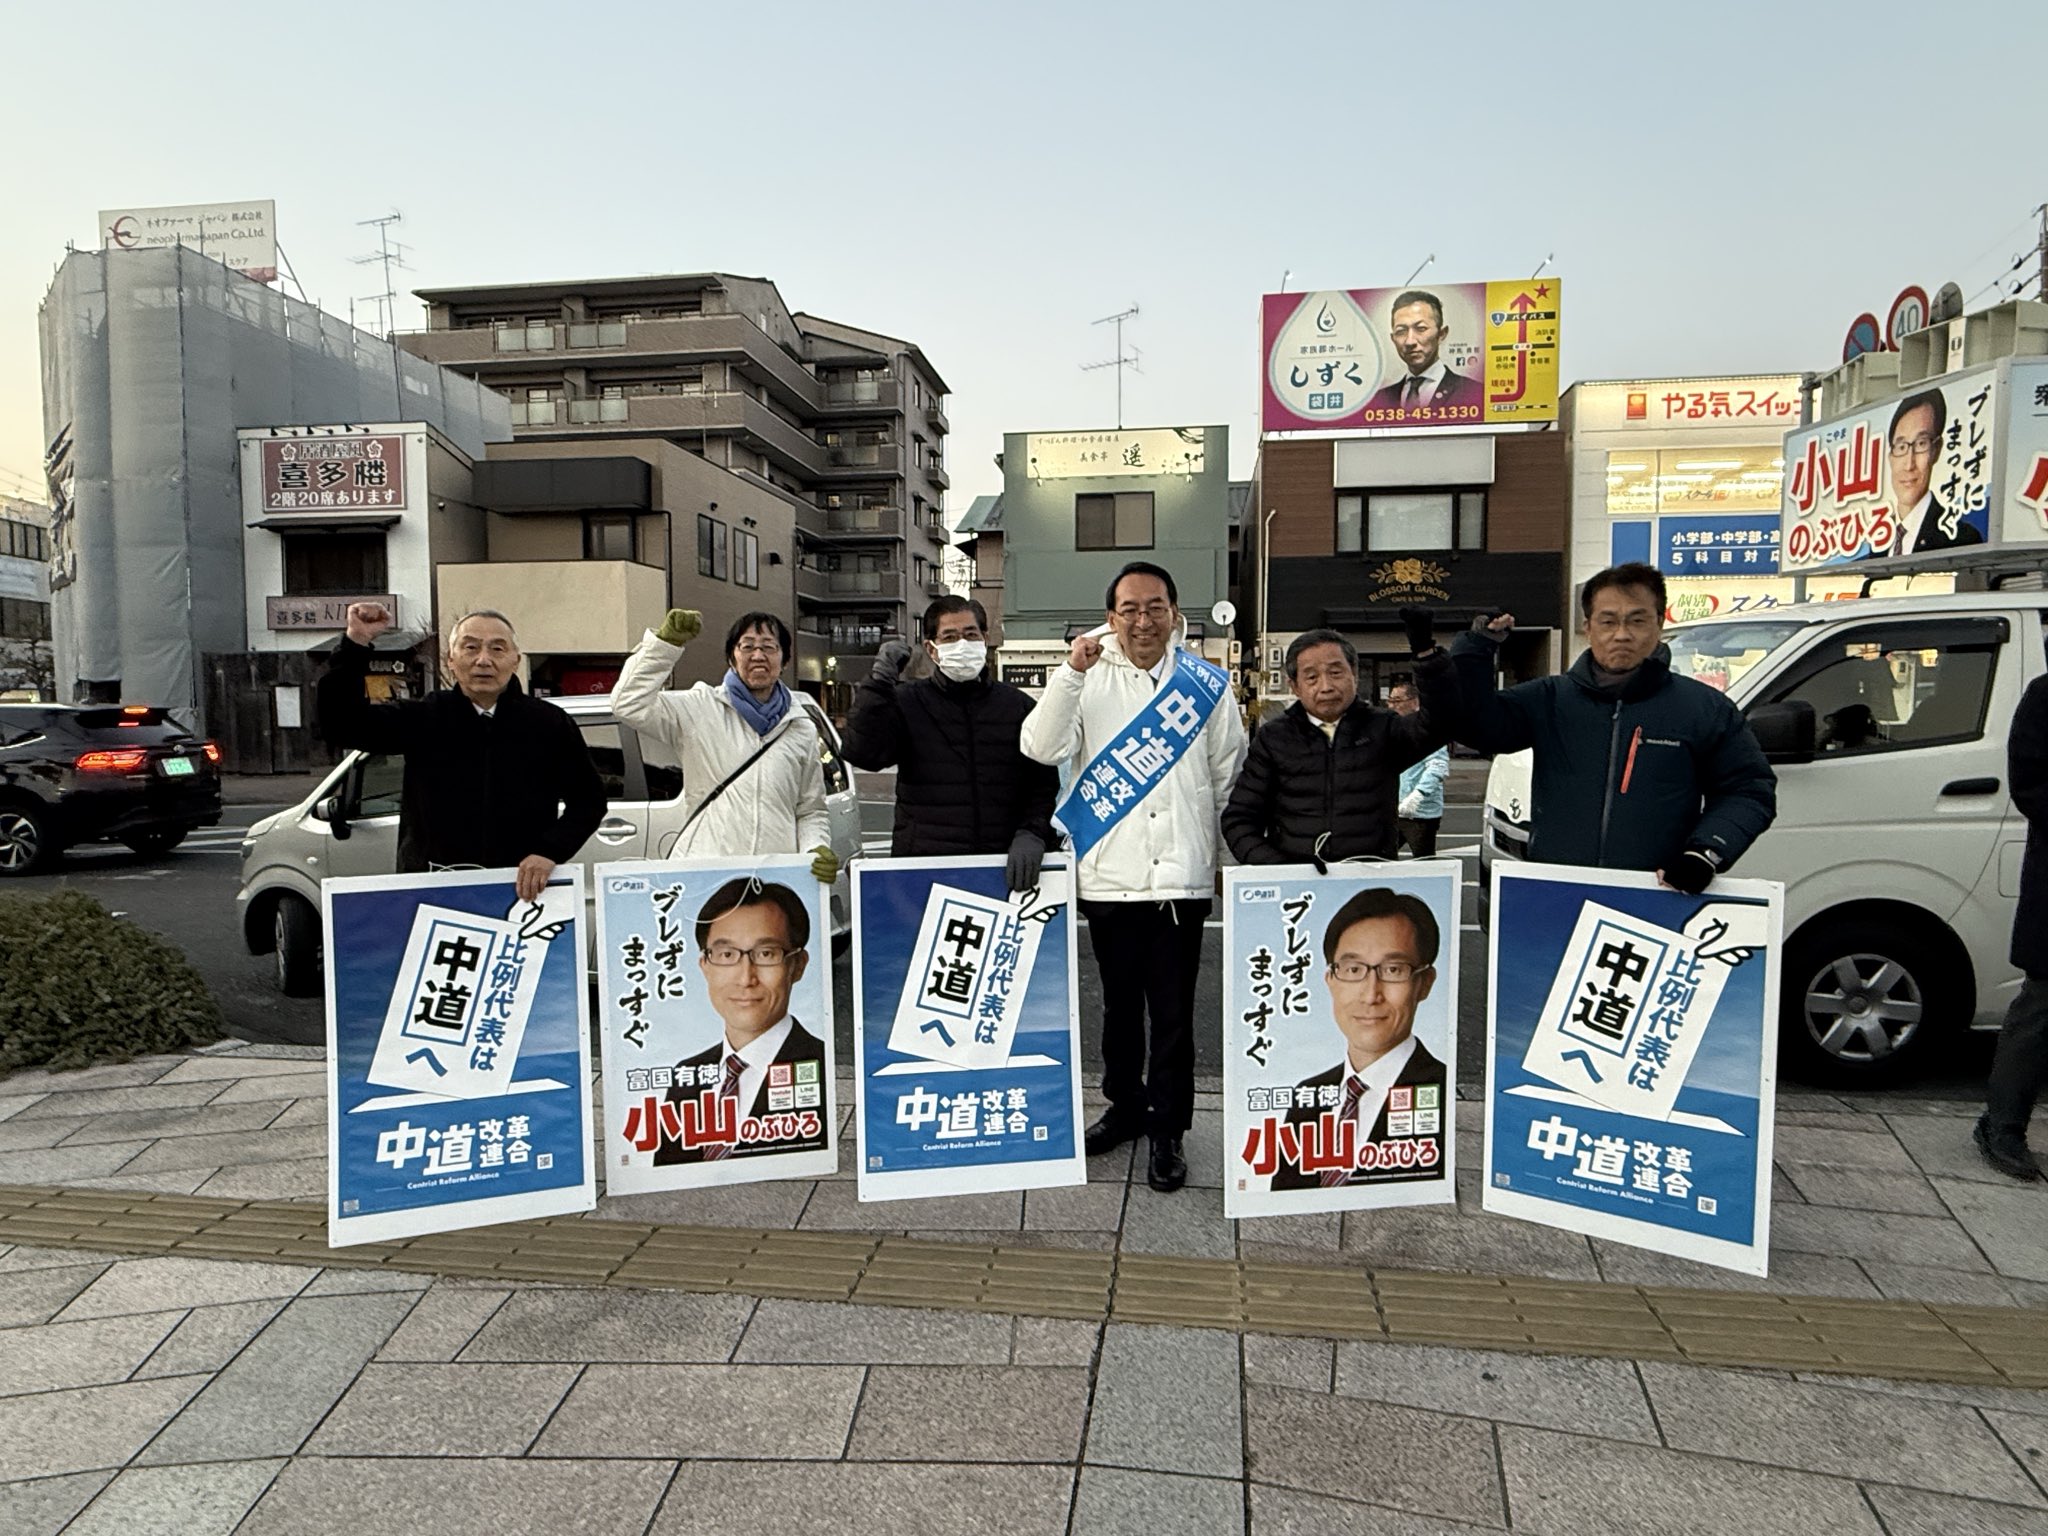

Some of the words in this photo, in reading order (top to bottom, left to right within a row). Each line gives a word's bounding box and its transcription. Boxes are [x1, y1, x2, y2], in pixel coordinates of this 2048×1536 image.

[1512, 312, 1546, 321] バイパス
[1895, 303, 1919, 339] 40
[1290, 360, 1363, 388] しずく
[1311, 394, 1341, 407] 袋井
[1365, 405, 1480, 422] 0538-45-1330
[1826, 428, 1847, 443] こやま
[1964, 384, 1991, 510] ブレずに
[278, 460, 387, 489] 喜多楼
[1791, 426, 1881, 512] 小山
[1940, 418, 1962, 536] まっすぐ
[271, 489, 396, 507] 2階20席あります
[1789, 506, 1893, 558] のぶひろ
[1368, 584, 1411, 602] BLOSSOM
[1414, 584, 1450, 601] GARDEN
[1181, 656, 1223, 696] 比例区
[1110, 688, 1201, 786] 中道
[1080, 760, 1119, 802] 連合
[1091, 777, 1136, 822] 改革
[653, 884, 684, 998] ブレずに
[1281, 894, 1313, 1015] ブレずに
[619, 936, 650, 1048] まっすぐ
[974, 915, 1024, 1045] 比例代表は
[469, 933, 528, 1072] 比例代表は
[1244, 949, 1274, 1066] まっすぐ
[1627, 948, 1706, 1093] 比例代表は
[626, 1063, 720, 1091] 富国有徳
[895, 1086, 980, 1139] 中道
[982, 1087, 1028, 1111] 改革
[1248, 1084, 1341, 1111] 富国有徳
[478, 1115, 531, 1141] 改革
[983, 1111, 1030, 1136] 連合
[375, 1121, 476, 1175] 中道
[479, 1140, 532, 1168] 連合
[949, 1141, 974, 1149] Reform
[1527, 1115, 1630, 1185] 中道
[1632, 1139, 1693, 1173] 改革
[438, 1176, 467, 1186] Reform
[1588, 1183, 1618, 1196] Reform
[1632, 1164, 1694, 1199] 連合
